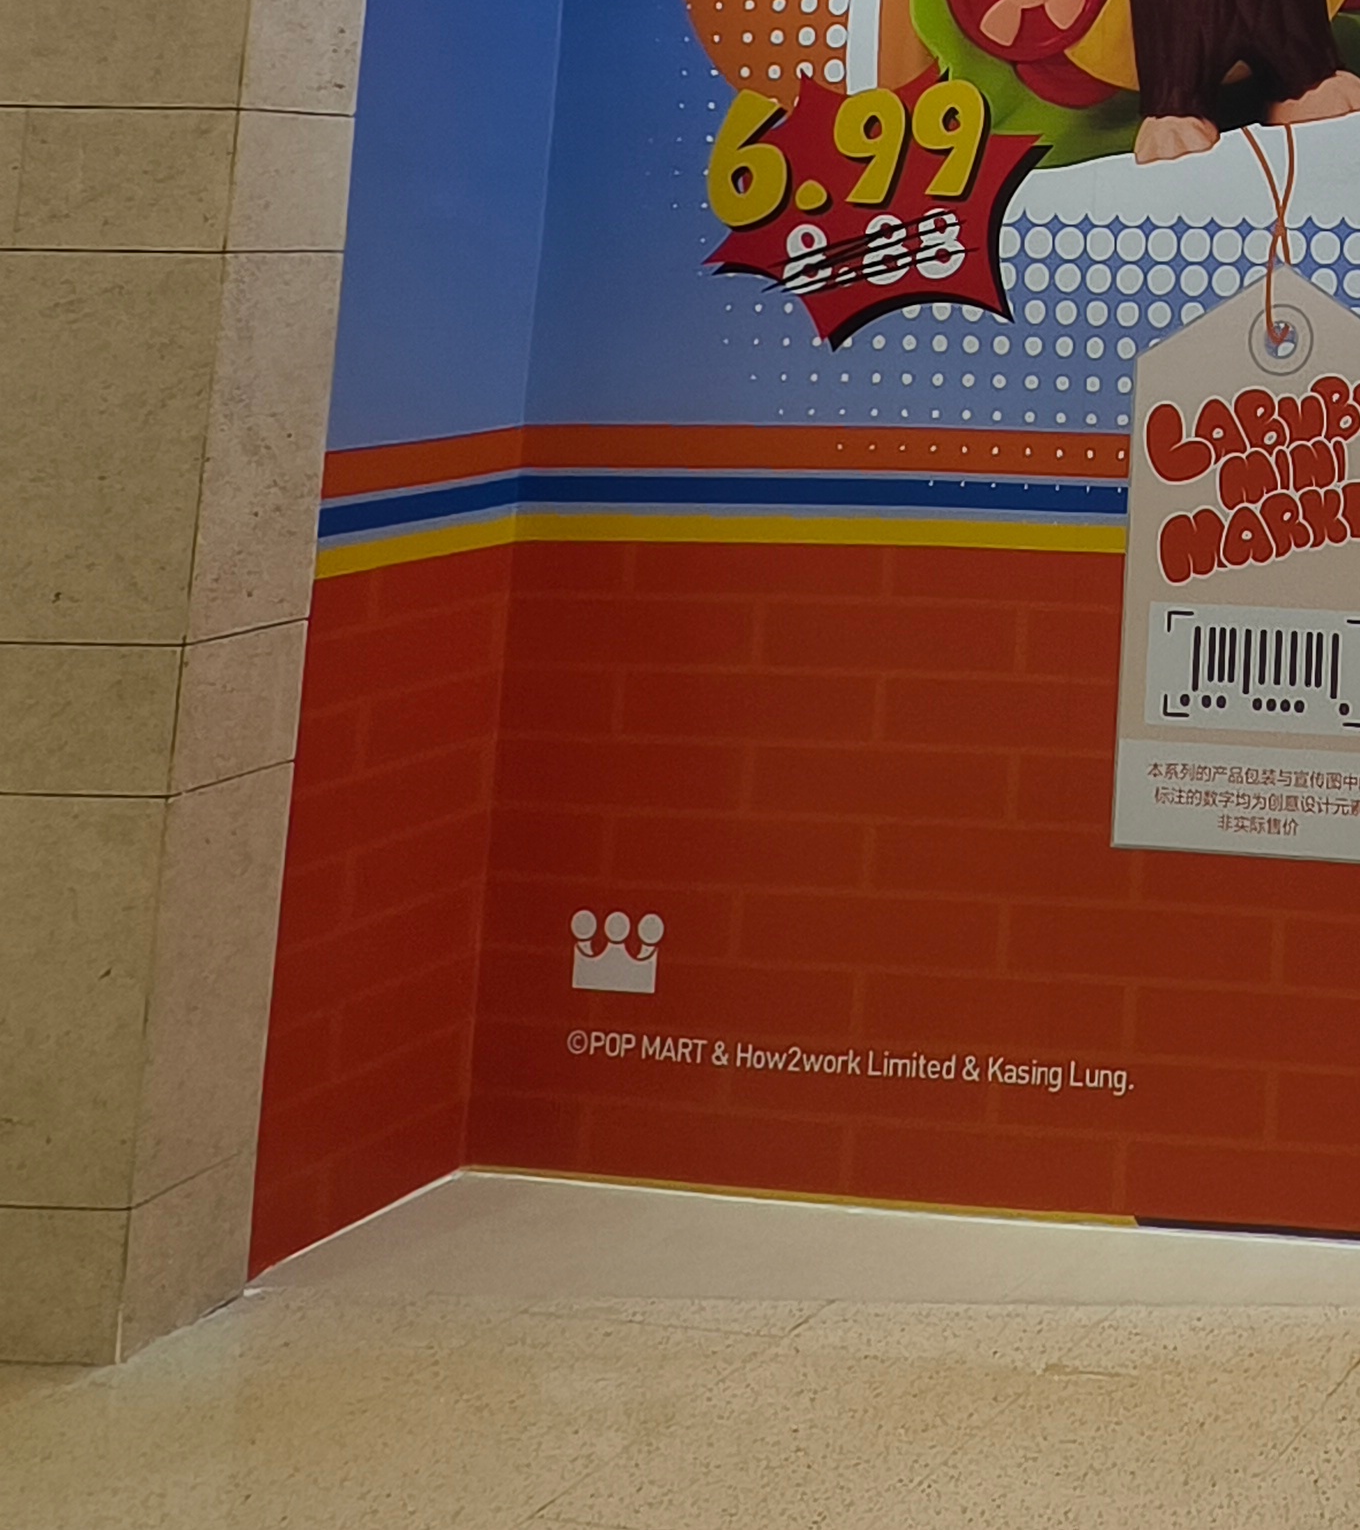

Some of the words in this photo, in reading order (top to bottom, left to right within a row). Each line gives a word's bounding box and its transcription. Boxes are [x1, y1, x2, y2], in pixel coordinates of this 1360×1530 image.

[706, 78, 988, 228] 6.99
[1217, 438, 1348, 513] MINI
[1217, 814, 1300, 837] 非实际售价
[641, 1035, 708, 1066] MART
[711, 1041, 729, 1068] &
[735, 1042, 862, 1078] How2work
[867, 1049, 956, 1082] Limited
[961, 1055, 981, 1083] &
[987, 1057, 1064, 1093] Kasing
[1068, 1060, 1136, 1097] Lung.
